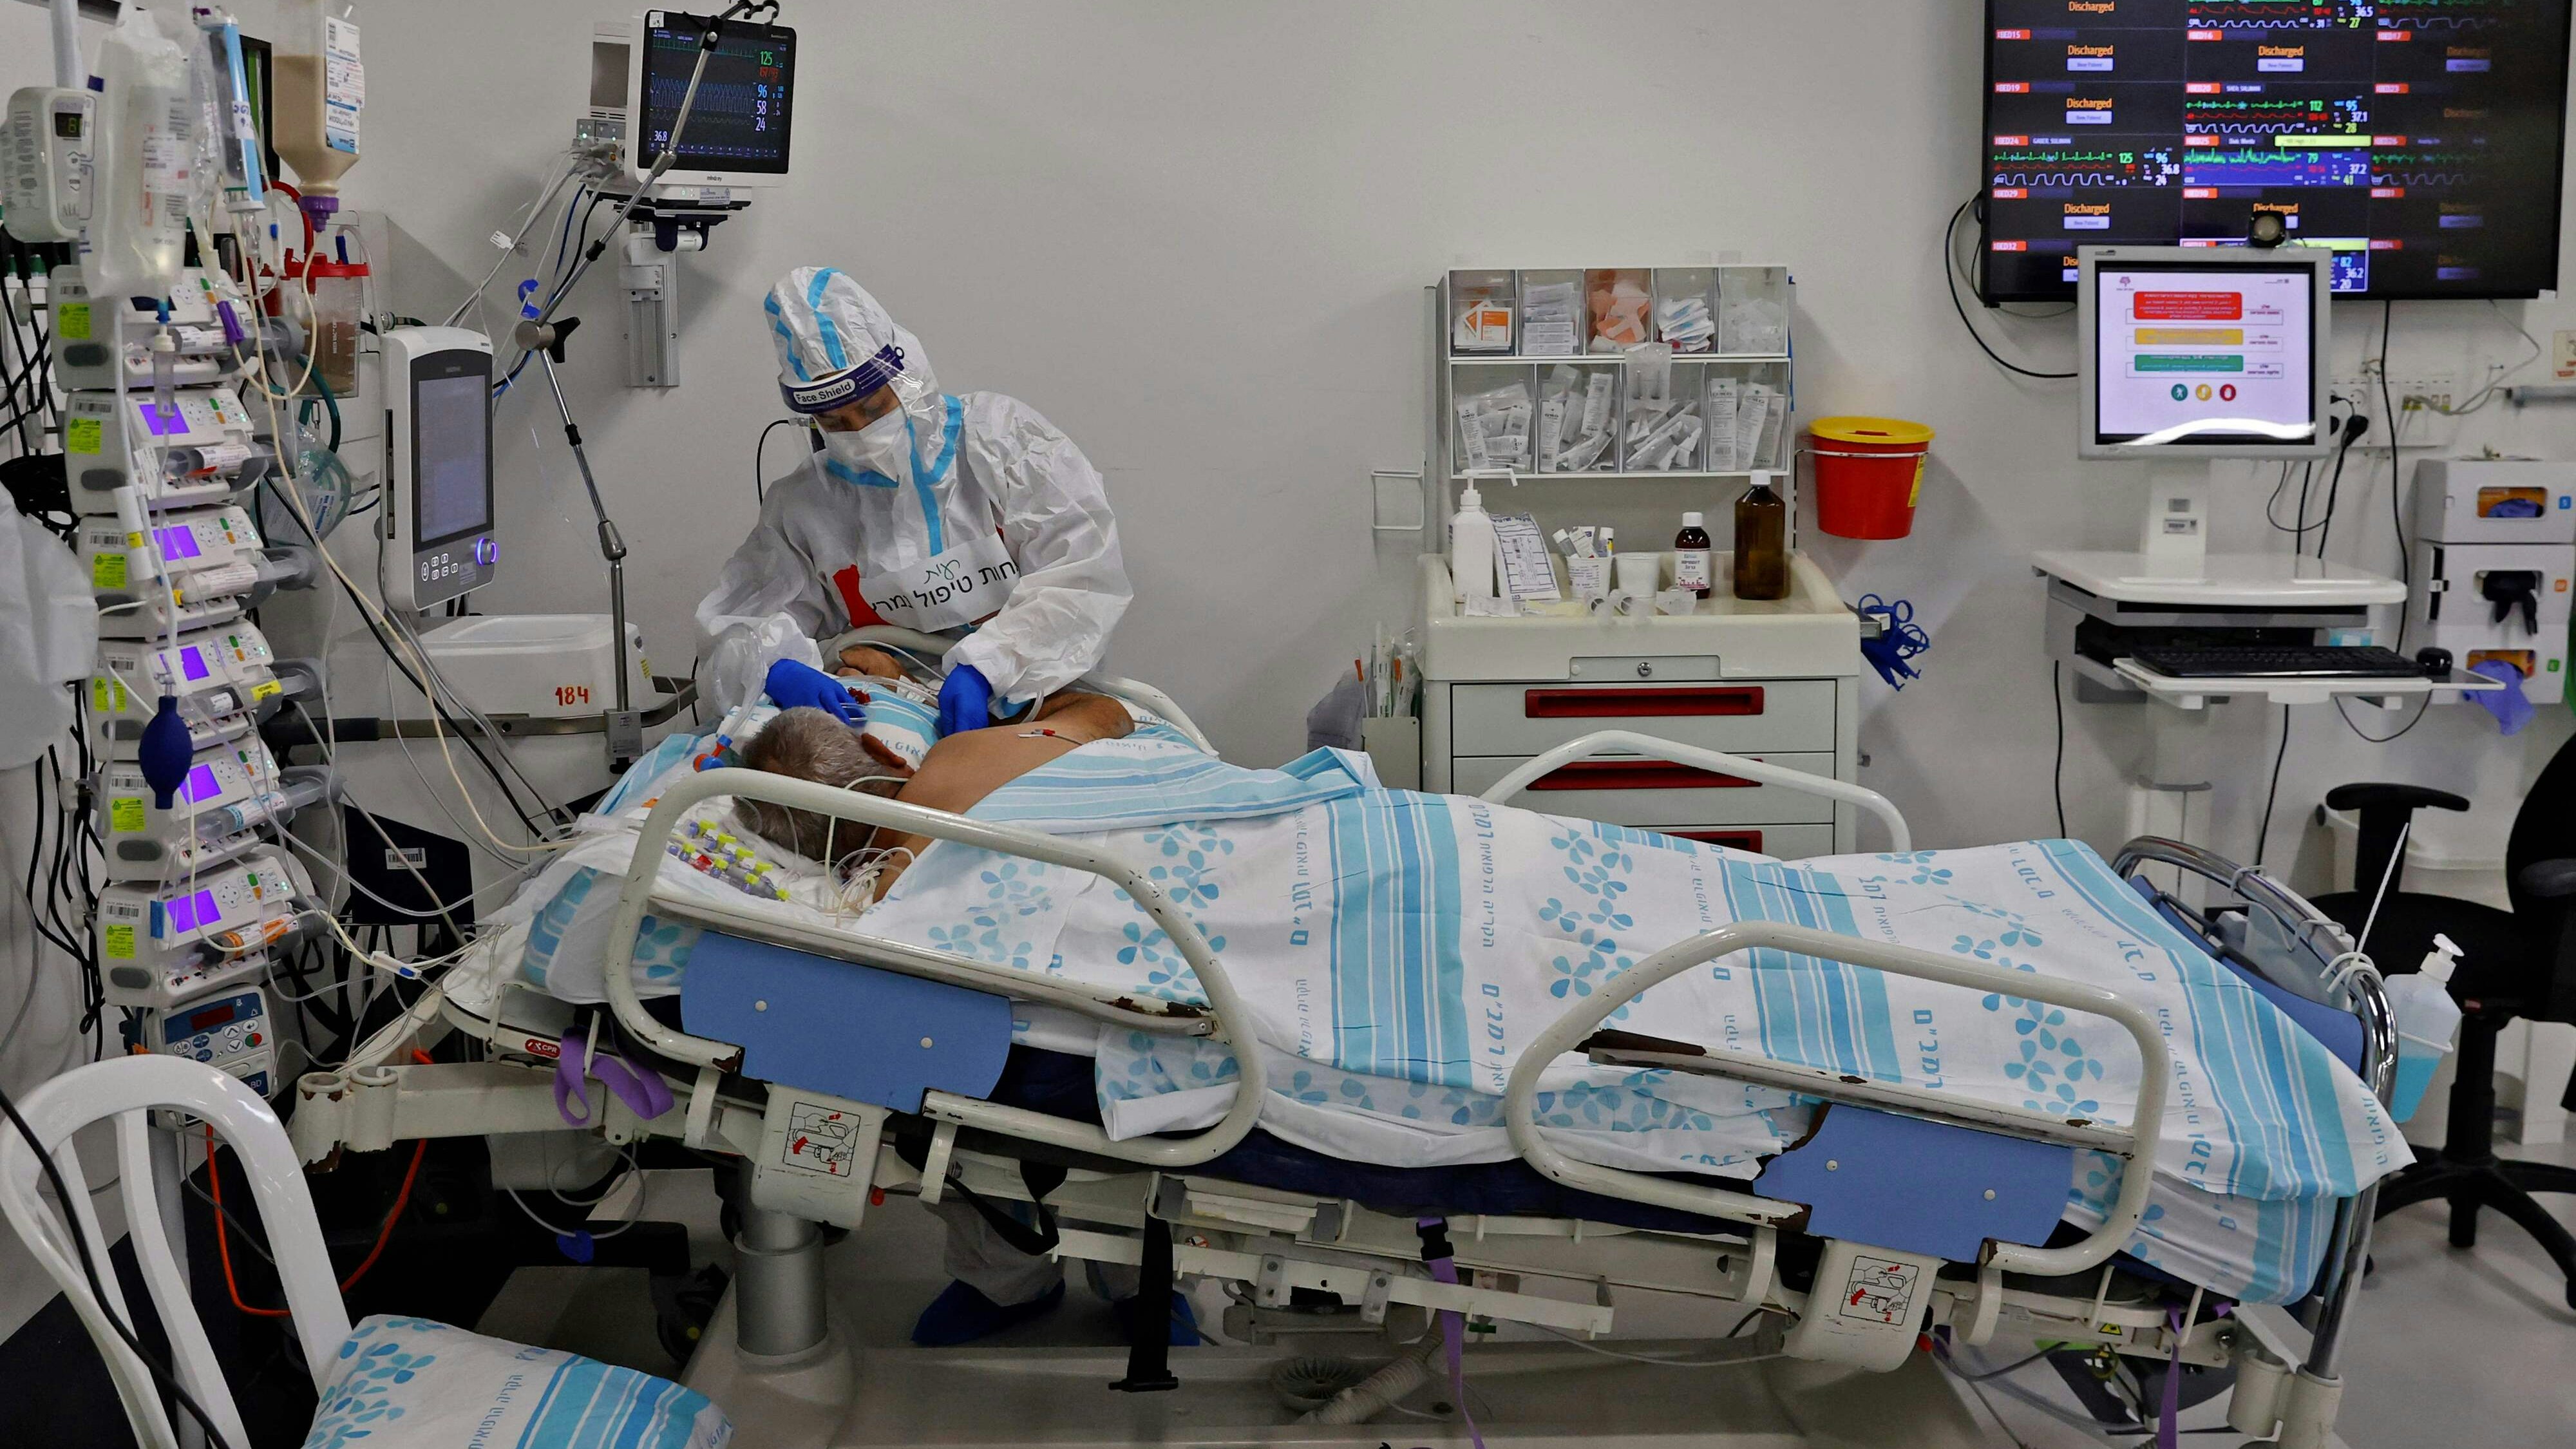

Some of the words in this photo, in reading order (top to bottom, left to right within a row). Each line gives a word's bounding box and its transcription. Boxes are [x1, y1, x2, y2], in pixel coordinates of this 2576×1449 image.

[2069, 1, 2114, 14] Discharged
[2068, 45, 2114, 57] Discharged
[2259, 46, 2304, 58] Discharged
[760, 51, 773, 66] 125
[758, 84, 767, 98] 96
[757, 100, 766, 115] 58
[2067, 98, 2112, 110] Discharged
[2309, 100, 2323, 111] 112
[2345, 100, 2358, 111] 95
[755, 117, 765, 131] 24
[2351, 112, 2367, 122] 37.1
[654, 130, 667, 142] 36.8
[2119, 153, 2133, 164] 125
[2156, 153, 2168, 164] 96
[2161, 164, 2180, 175] 36.8
[2349, 164, 2367, 175] 37.2
[2155, 175, 2167, 185] 24
[2064, 204, 2110, 216] Discharged
[796, 393, 817, 402] Face
[819, 382, 851, 399] Shield
[913, 575, 973, 609] טיפול
[555, 686, 588, 706] 184
[1481, 844, 1495, 894] הרפואית
[1859, 877, 1886, 900] רמב
[1694, 876, 1712, 923] הרפואית
[1290, 882, 1313, 946] רמב"ם
[1481, 900, 1495, 949] הקריה
[1296, 978, 1309, 1014] הקריה
[1482, 983, 1506, 1056] רמב"ם
[1297, 1017, 1312, 1057] הרפוא
[542, 1044, 558, 1053] CPR
[1913, 1009, 1944, 1088] רמב"ם
[251, 1079, 262, 1088] BD
[497, 1374, 523, 1404] הקריה
